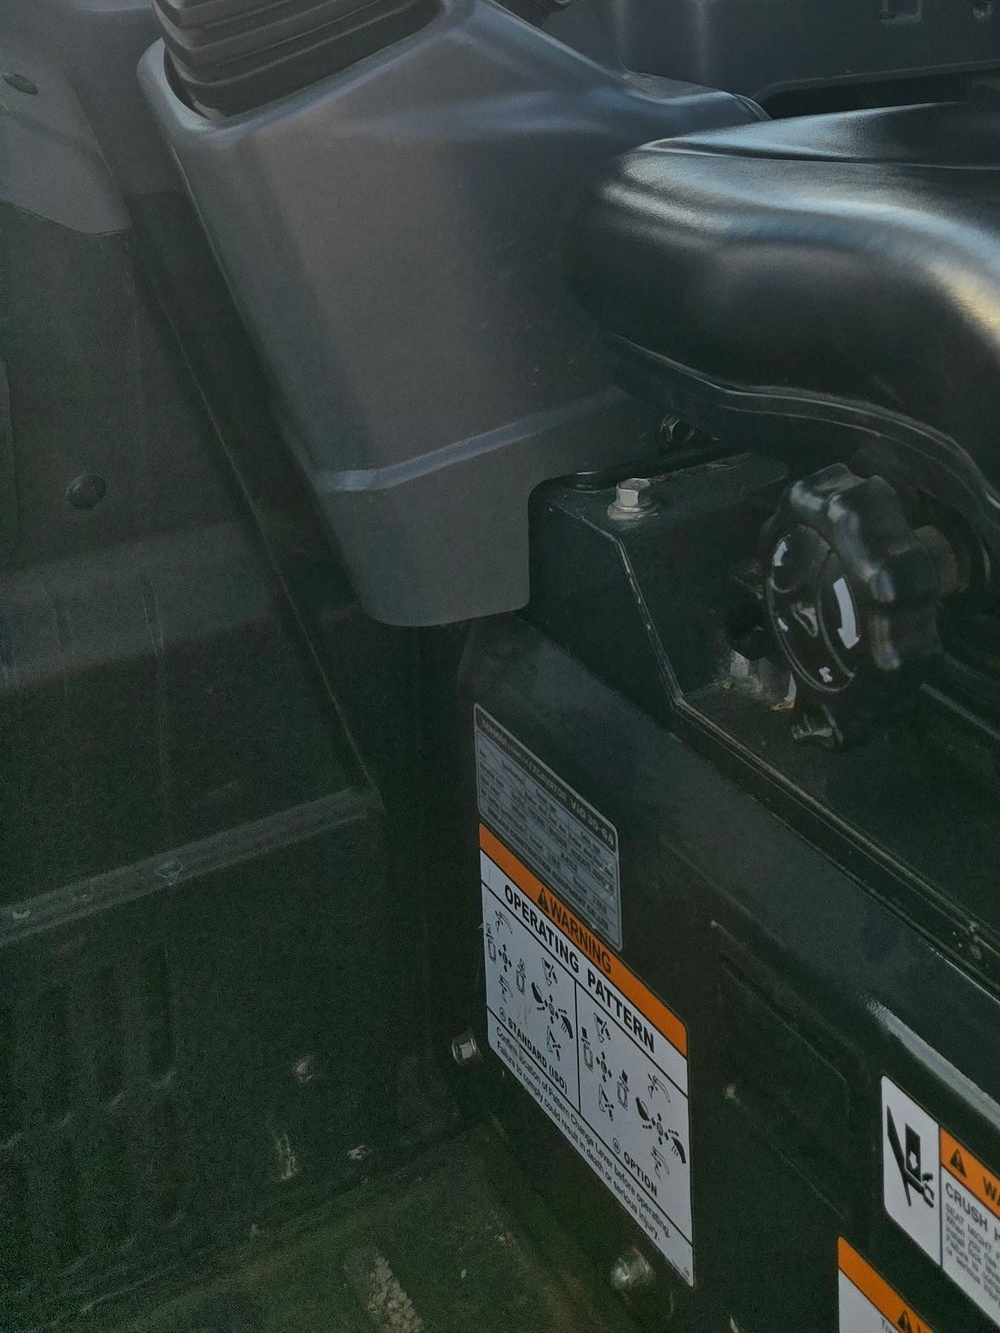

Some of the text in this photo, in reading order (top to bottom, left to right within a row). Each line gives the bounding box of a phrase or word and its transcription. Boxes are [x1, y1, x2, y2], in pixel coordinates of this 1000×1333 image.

[504, 884, 580, 975] OPERATING
[588, 968, 655, 1055] PATTERN
[550, 905, 612, 975] WARNING
[508, 1017, 547, 1068] STANDARD
[571, 1115, 594, 1145] Change
[614, 1164, 635, 1195] before
[624, 1151, 658, 1197] OPTION
[945, 1182, 988, 1232] CRUSH
